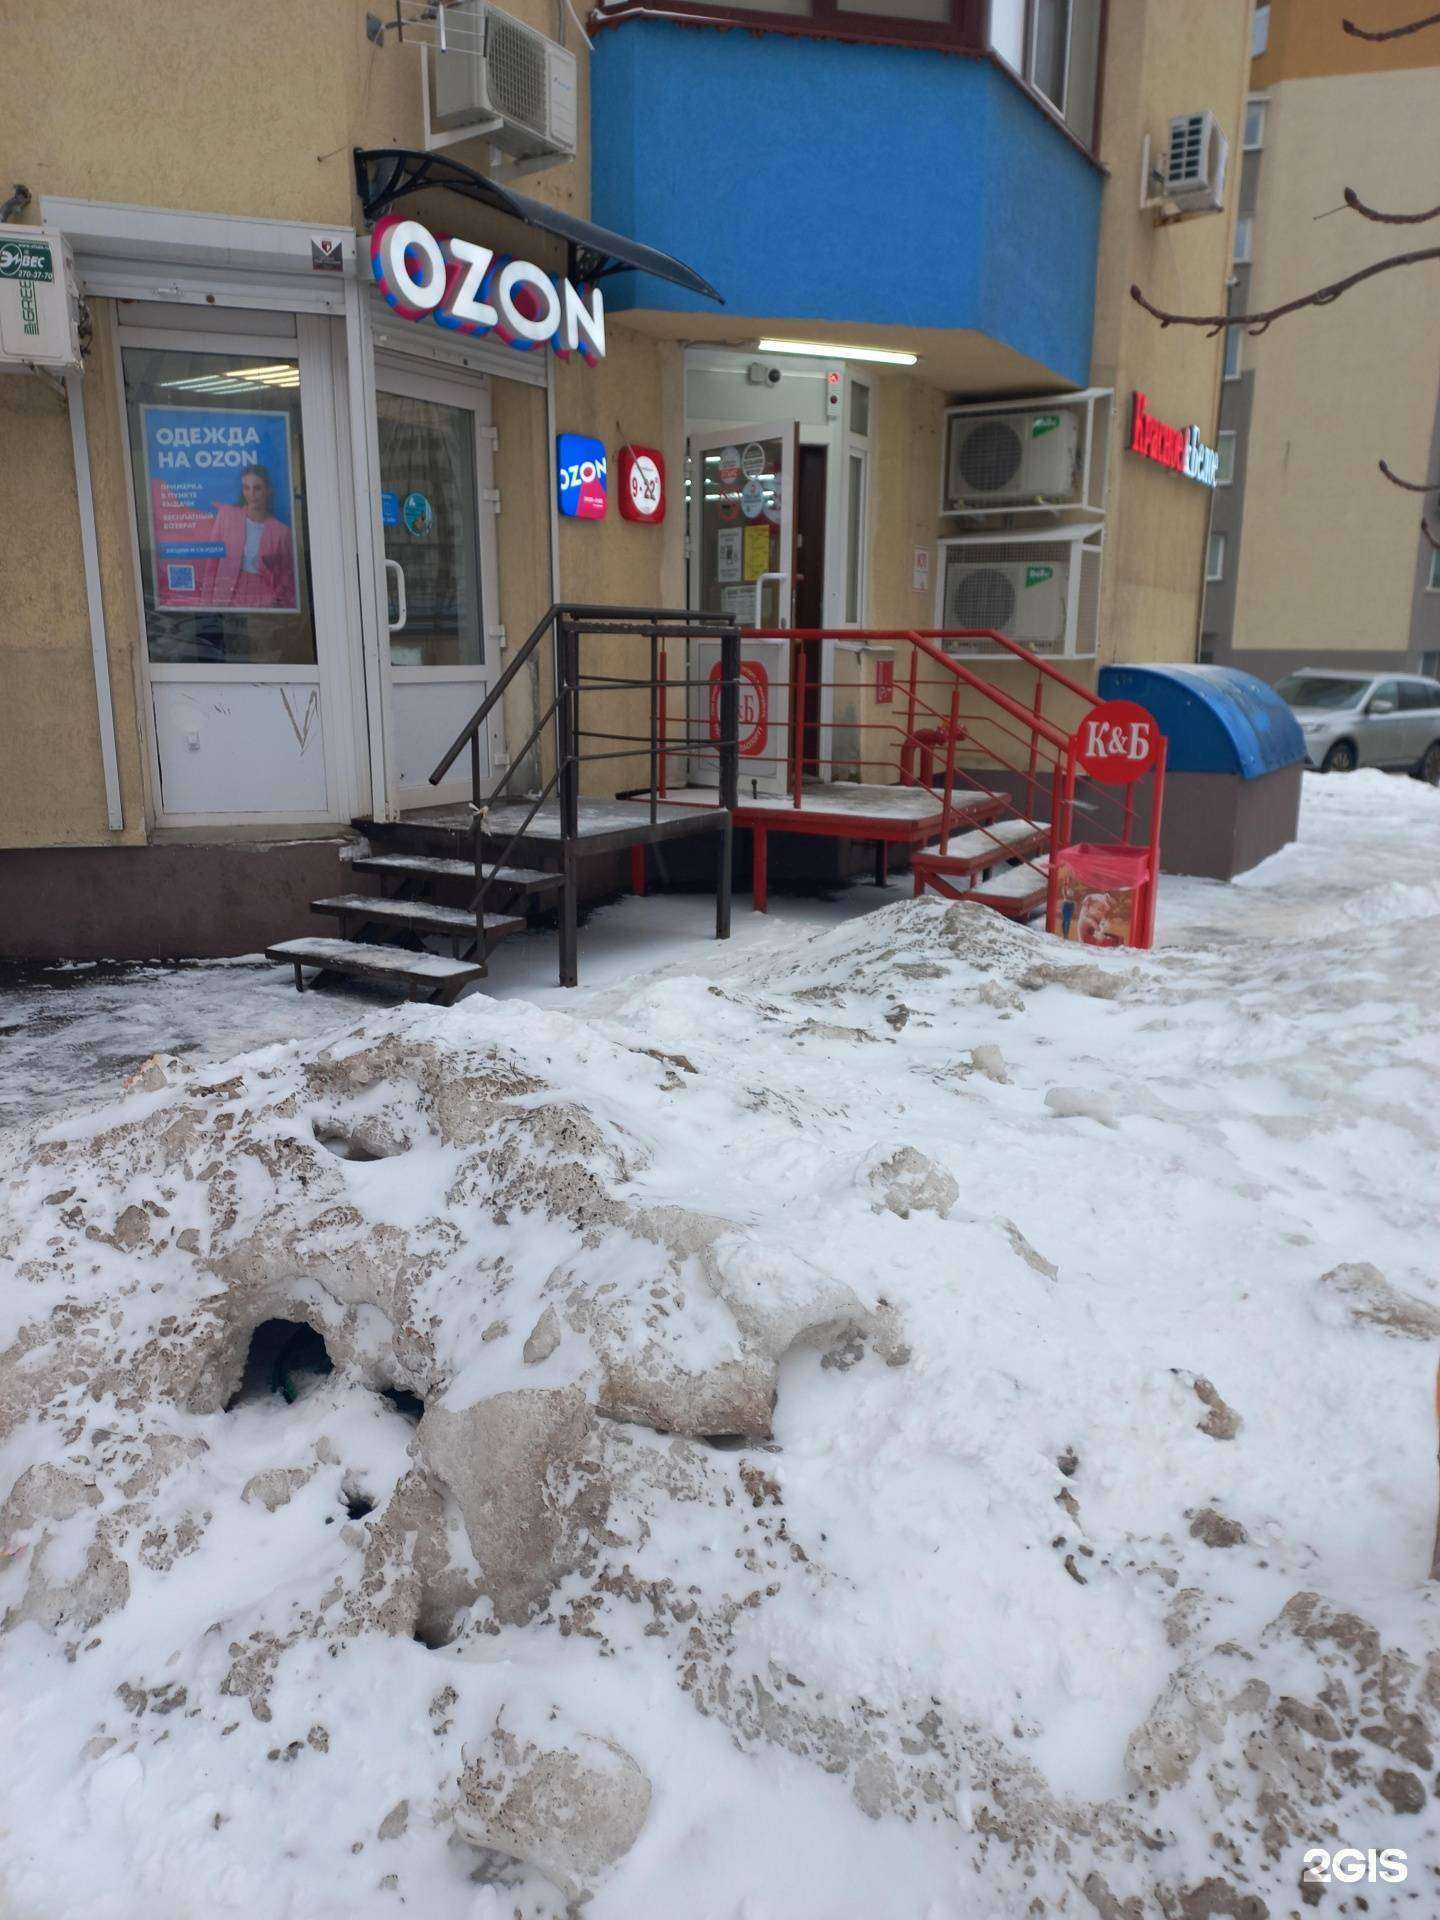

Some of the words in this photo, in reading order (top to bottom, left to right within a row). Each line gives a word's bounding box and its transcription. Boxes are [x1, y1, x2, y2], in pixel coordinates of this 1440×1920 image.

[378, 217, 607, 358] OZON
[156, 426, 260, 447] ОДЕЖДА
[159, 451, 190, 468] НА
[195, 450, 258, 468] OZON
[560, 456, 607, 490] OZON
[1085, 721, 1151, 760] К&Б
